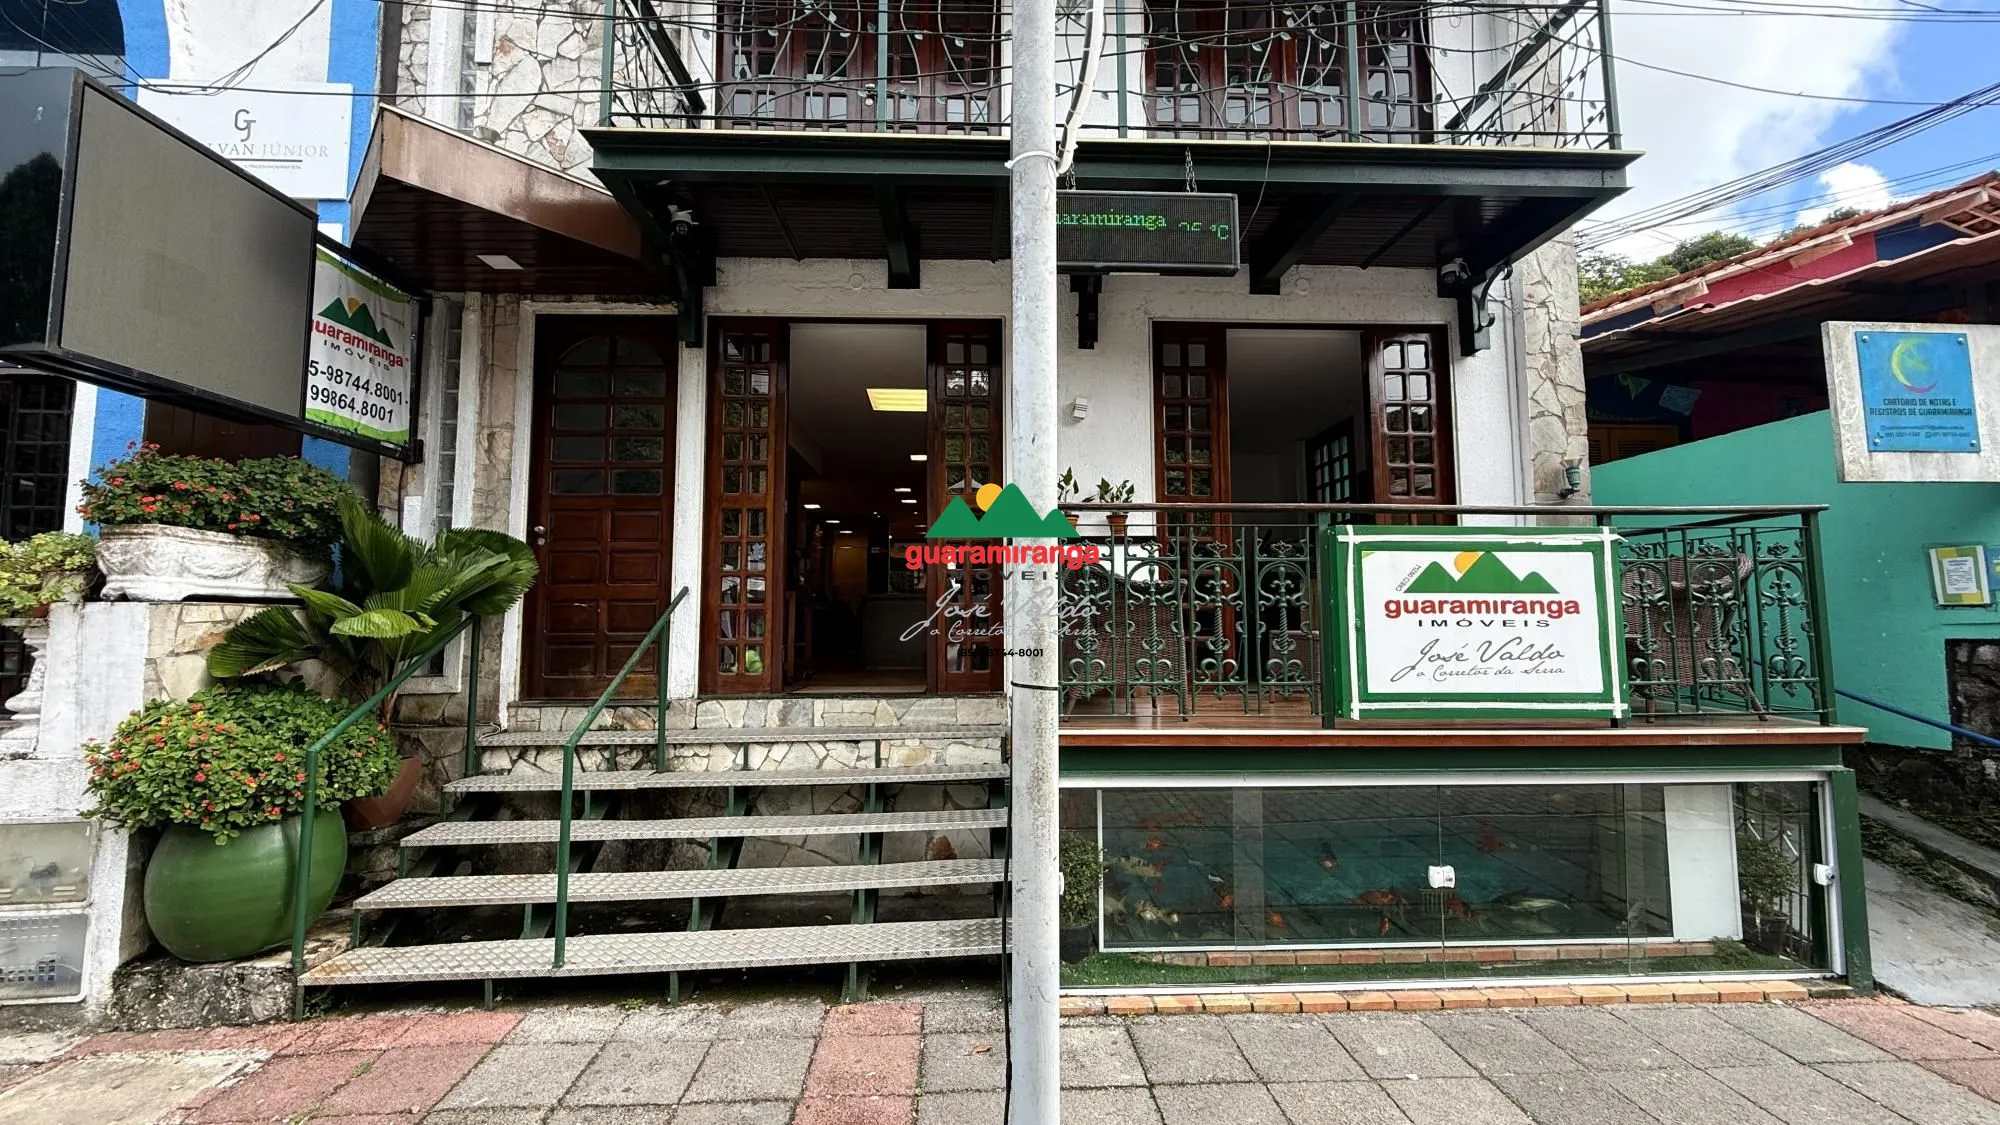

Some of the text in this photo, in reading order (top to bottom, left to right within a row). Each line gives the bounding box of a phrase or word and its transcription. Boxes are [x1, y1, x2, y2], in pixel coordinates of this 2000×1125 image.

[311, 319, 404, 368] uaramiranga
[310, 384, 394, 424] 99864.8001
[1869, 408, 1973, 417] REGISTROS DE GUARAMIRANGA
[1384, 599, 1580, 619] guaramiranga
[1418, 617, 1550, 628] IMÓVEIS
[1390, 636, 1565, 682] José Valdo
[1433, 664, 1494, 682] Corretor
[1494, 665, 1514, 676] da
[1520, 660, 1566, 675] Serra
